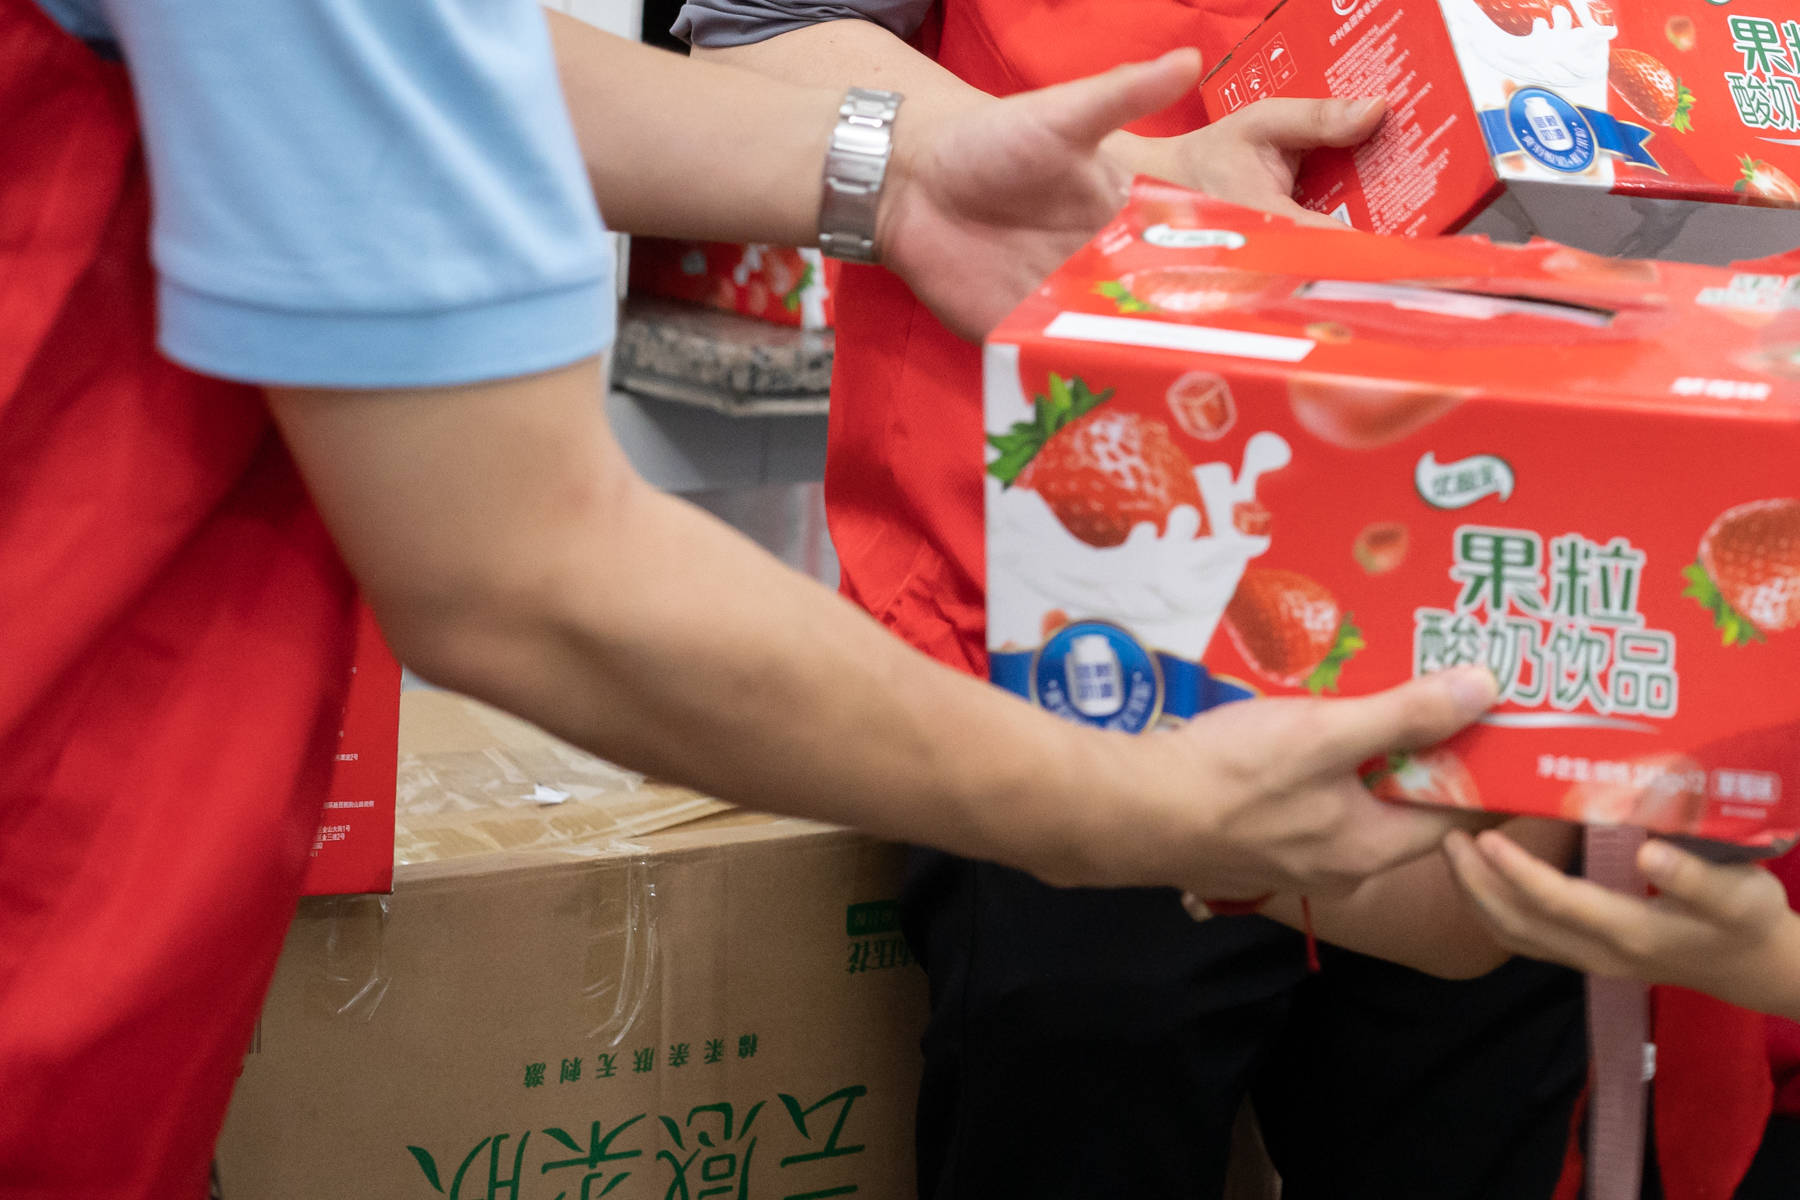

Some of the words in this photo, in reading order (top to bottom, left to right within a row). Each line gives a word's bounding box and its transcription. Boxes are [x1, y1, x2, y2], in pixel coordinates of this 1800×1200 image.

[1448, 524, 1647, 626] 果粒
[1413, 607, 1679, 719] 酸奶饮品
